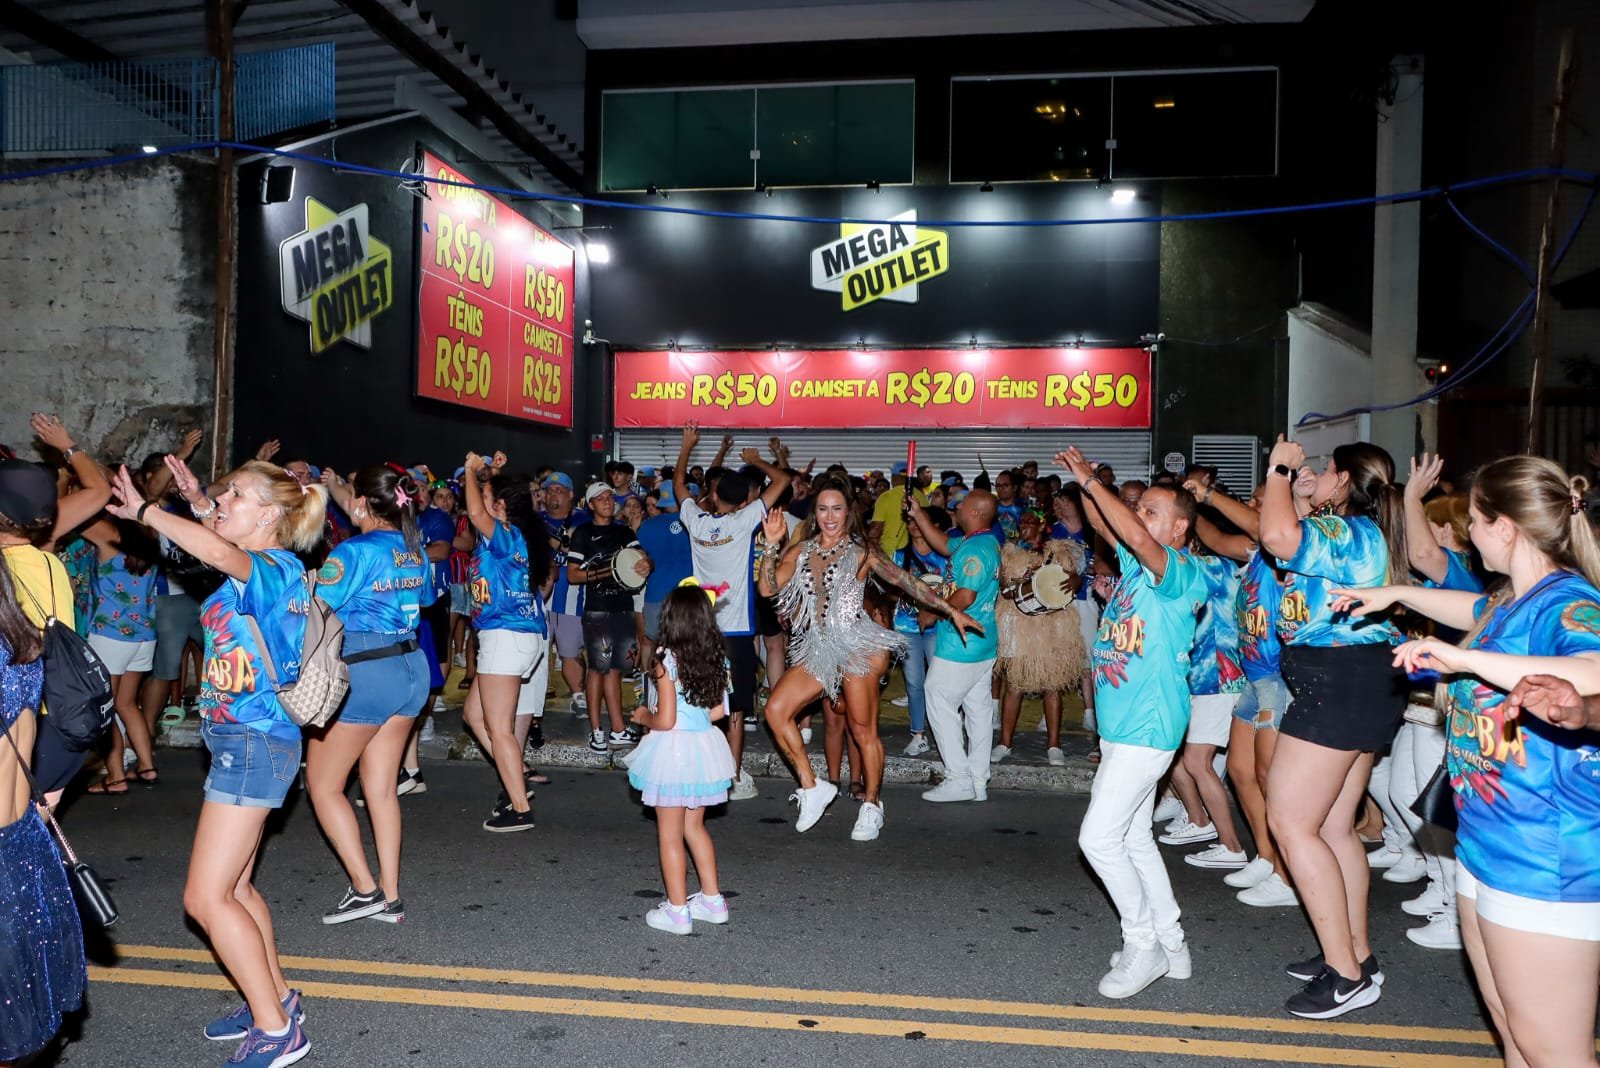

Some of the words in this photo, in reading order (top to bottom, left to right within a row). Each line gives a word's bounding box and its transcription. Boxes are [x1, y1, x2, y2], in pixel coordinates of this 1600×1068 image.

[292, 217, 364, 300] MEGA
[436, 212, 495, 290] R$20
[820, 222, 909, 279] MEGA
[847, 240, 942, 304] OUTLET
[317, 258, 388, 344] OUTLET
[447, 289, 484, 338] TÊNIS
[524, 263, 565, 323] R$50
[434, 335, 492, 400] R$50
[523, 321, 563, 358] CAMISETA
[522, 354, 562, 406] R$25
[630, 382, 687, 400] JEANS
[691, 369, 779, 410] R$50
[789, 379, 880, 398] CAMISETA
[885, 367, 976, 409] R$20
[986, 375, 1040, 399] TÊNIS
[1043, 370, 1139, 412] R$50
